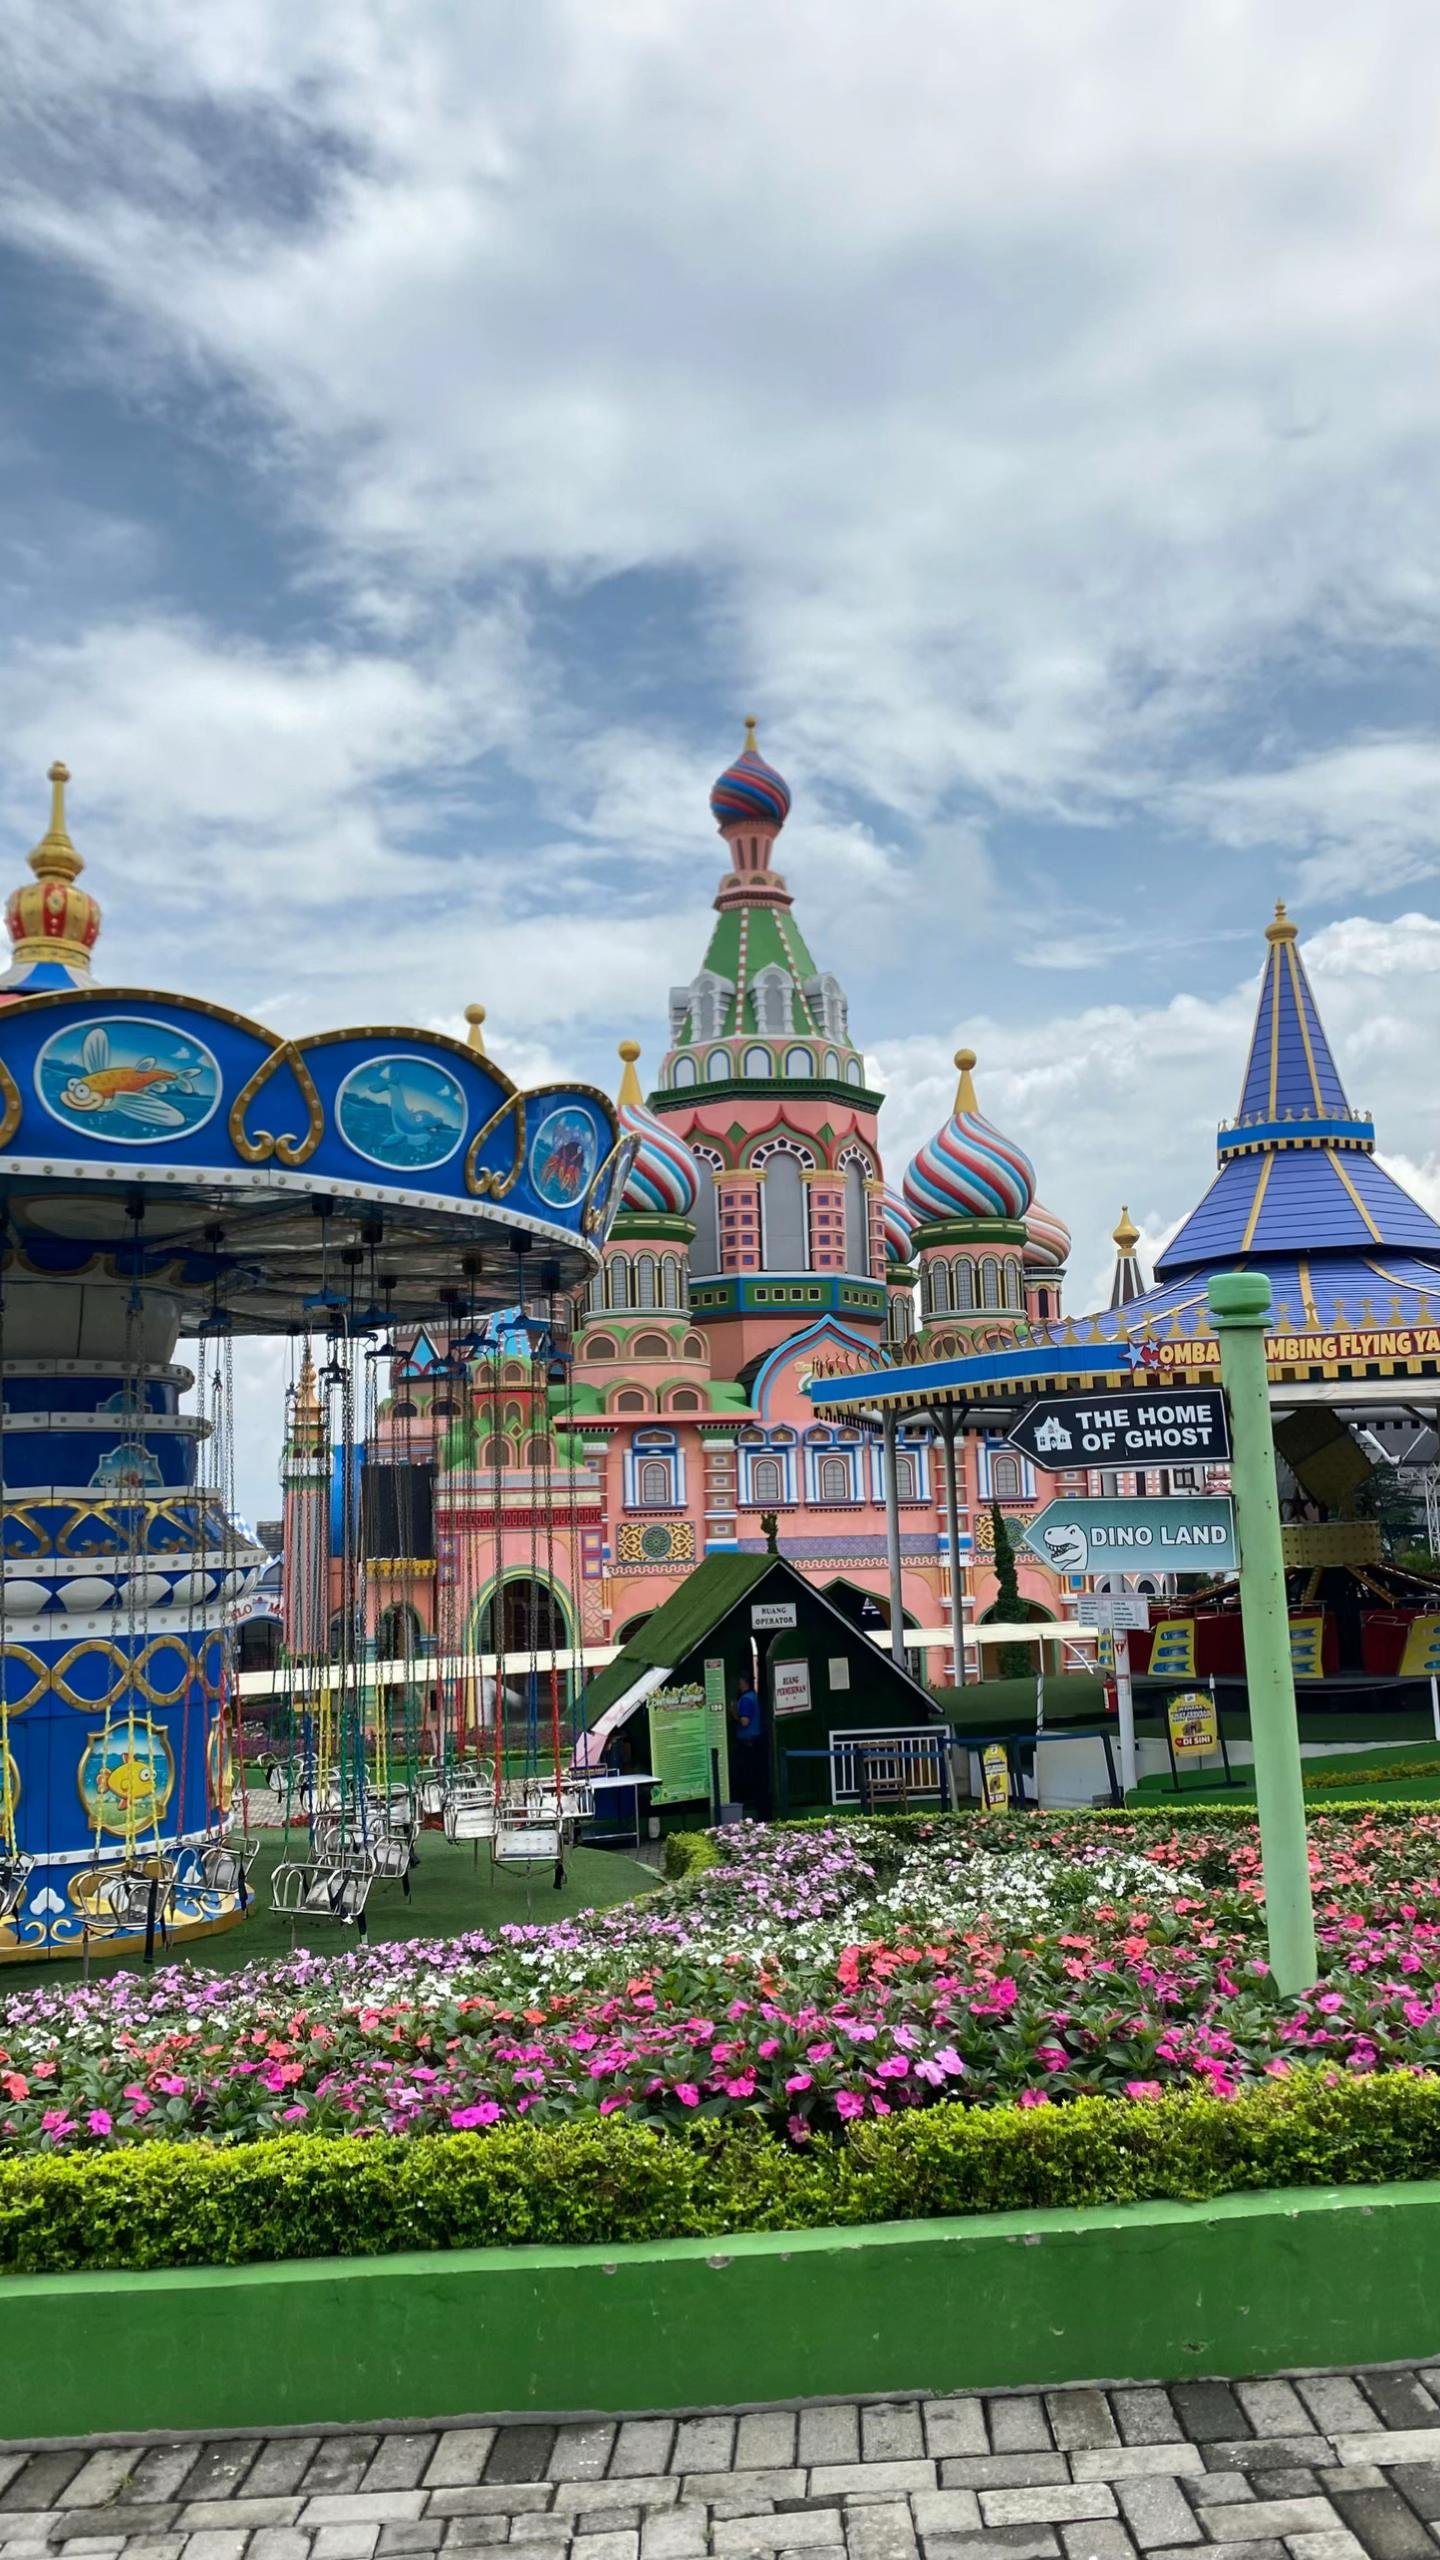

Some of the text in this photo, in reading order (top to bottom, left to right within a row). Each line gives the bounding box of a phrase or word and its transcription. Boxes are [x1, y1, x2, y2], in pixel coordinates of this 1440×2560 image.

[1159, 1329, 1440, 1364] OMBA MBING FLYING YA
[1075, 1405, 1213, 1430] THE HOME
[1082, 1427, 1213, 1451] OF GHOST
[1090, 1525, 1227, 1547] DINO LAND
[754, 1616, 794, 1626] OPERATOR
[761, 1607, 787, 1615] RUANG
[1183, 1738, 1193, 1746] DI
[1194, 1735, 1211, 1745] SINI
